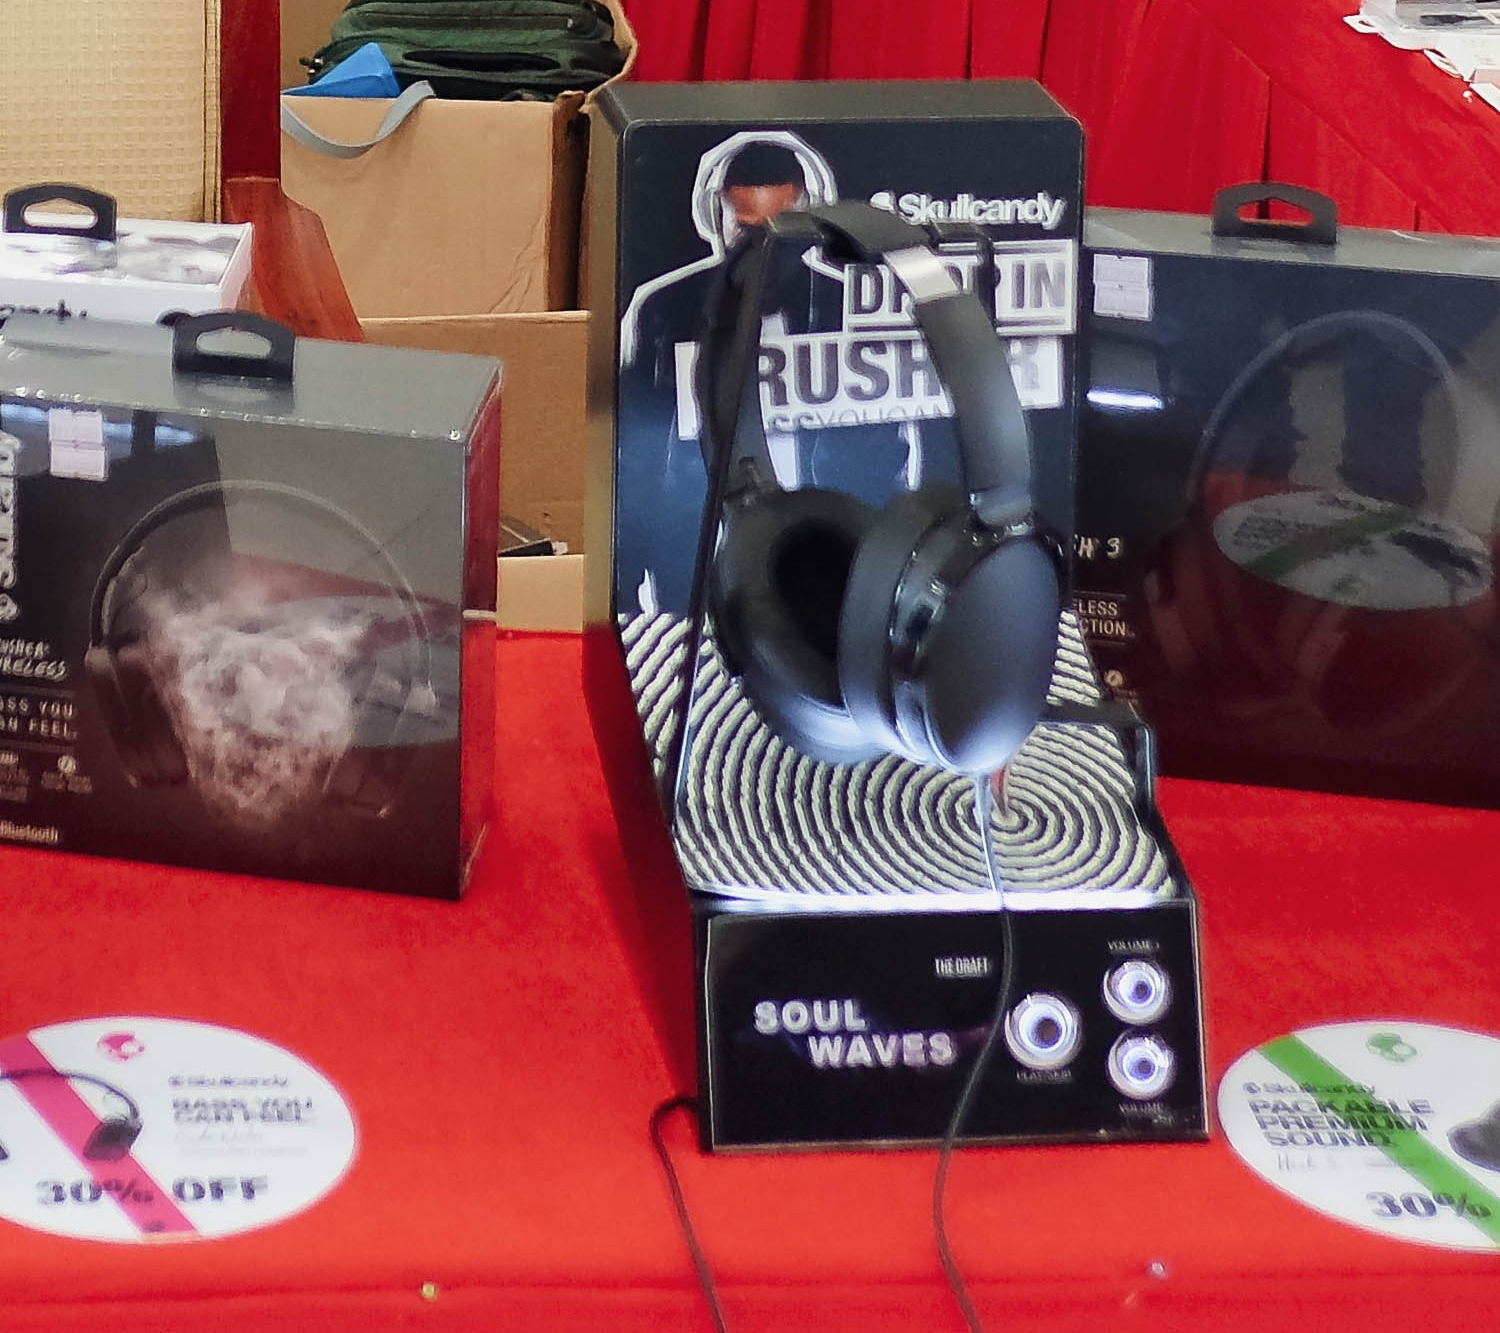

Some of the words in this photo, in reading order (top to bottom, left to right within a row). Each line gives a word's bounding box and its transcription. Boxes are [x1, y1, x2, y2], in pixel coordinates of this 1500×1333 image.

[898, 191, 1067, 229] Skullcandy
[1011, 261, 1068, 310] IN
[1106, 537, 1121, 559] 3
[1073, 598, 1119, 617] LESS
[1079, 618, 1127, 637] CTION
[38, 699, 75, 721] YOU
[0, 820, 60, 845] Bluetooth
[753, 998, 868, 1036] SOUL
[807, 1031, 959, 1070] WAVES
[1246, 1099, 1435, 1115] PACKABLE
[1256, 1116, 1429, 1131] PREMIUM
[36, 1177, 154, 1207] 30%
[171, 1174, 268, 1204] OFF
[1365, 1191, 1493, 1220] 30%
